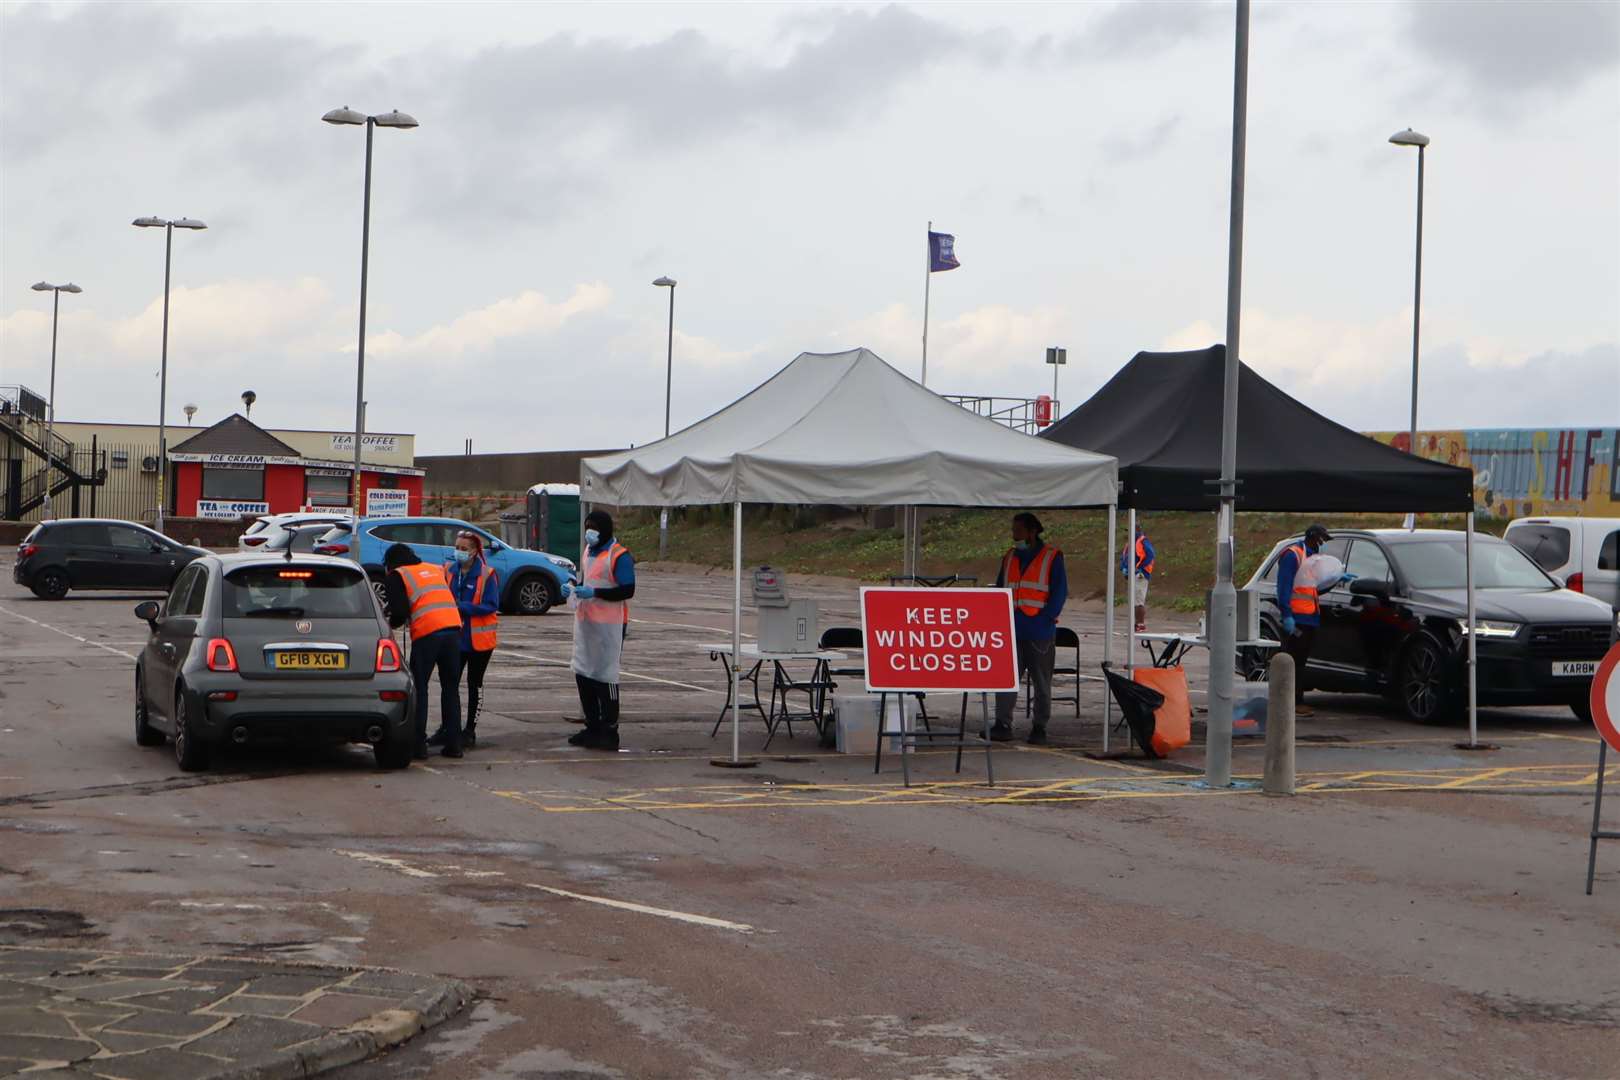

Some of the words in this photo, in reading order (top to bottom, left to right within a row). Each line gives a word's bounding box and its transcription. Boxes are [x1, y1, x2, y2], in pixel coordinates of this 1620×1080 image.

[332, 435, 352, 444] TEA
[360, 436, 396, 445] OFFEE
[209, 454, 225, 462] ICE
[227, 455, 265, 463] CREAM
[200, 502, 218, 511] TEA
[230, 503, 266, 513] COFFEE
[906, 607, 969, 625] KEEP
[875, 630, 1004, 648] WINDOWS
[280, 653, 310, 665] GF18
[314, 653, 339, 665] XGW
[890, 653, 992, 671] CLOSED
